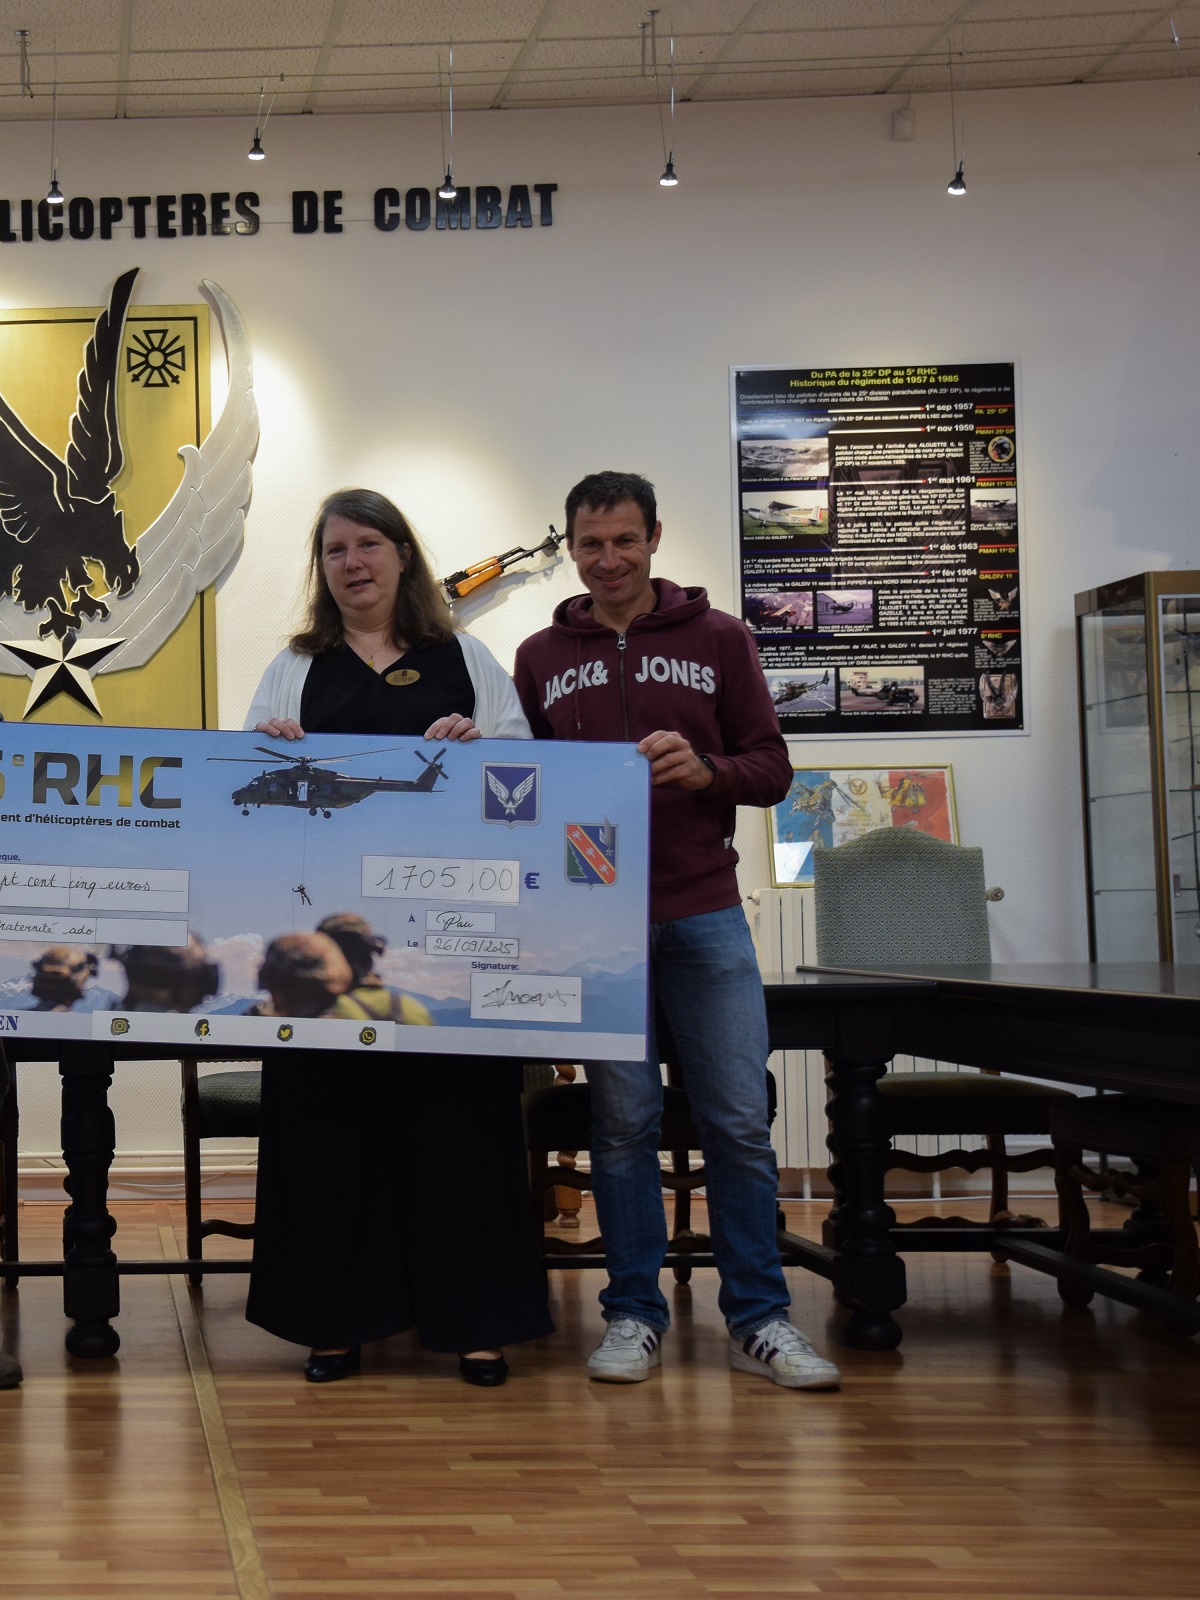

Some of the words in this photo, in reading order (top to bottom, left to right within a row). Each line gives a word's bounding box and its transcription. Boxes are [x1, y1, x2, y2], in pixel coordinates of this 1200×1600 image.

[292, 190, 343, 234] DE
[374, 183, 558, 231] COMBAT
[790, 379, 836, 388] Historique
[851, 377, 891, 386] régiment
[544, 660, 608, 709] JACK&
[635, 656, 715, 694] JONES
[32, 752, 183, 808] RHC
[25, 812, 112, 827] d'hélicoptères
[116, 817, 131, 828] de
[134, 818, 180, 828] combat
[28, 874, 56, 888] cent
[69, 877, 96, 898] cinq
[101, 878, 150, 892] euros
[376, 865, 514, 894] 1705,00
[524, 872, 540, 889] €
[408, 913, 416, 924] À
[436, 910, 474, 931] Pau
[407, 939, 418, 948] Le
[433, 936, 514, 954] 26/09/2025
[471, 961, 519, 972] Signature:
